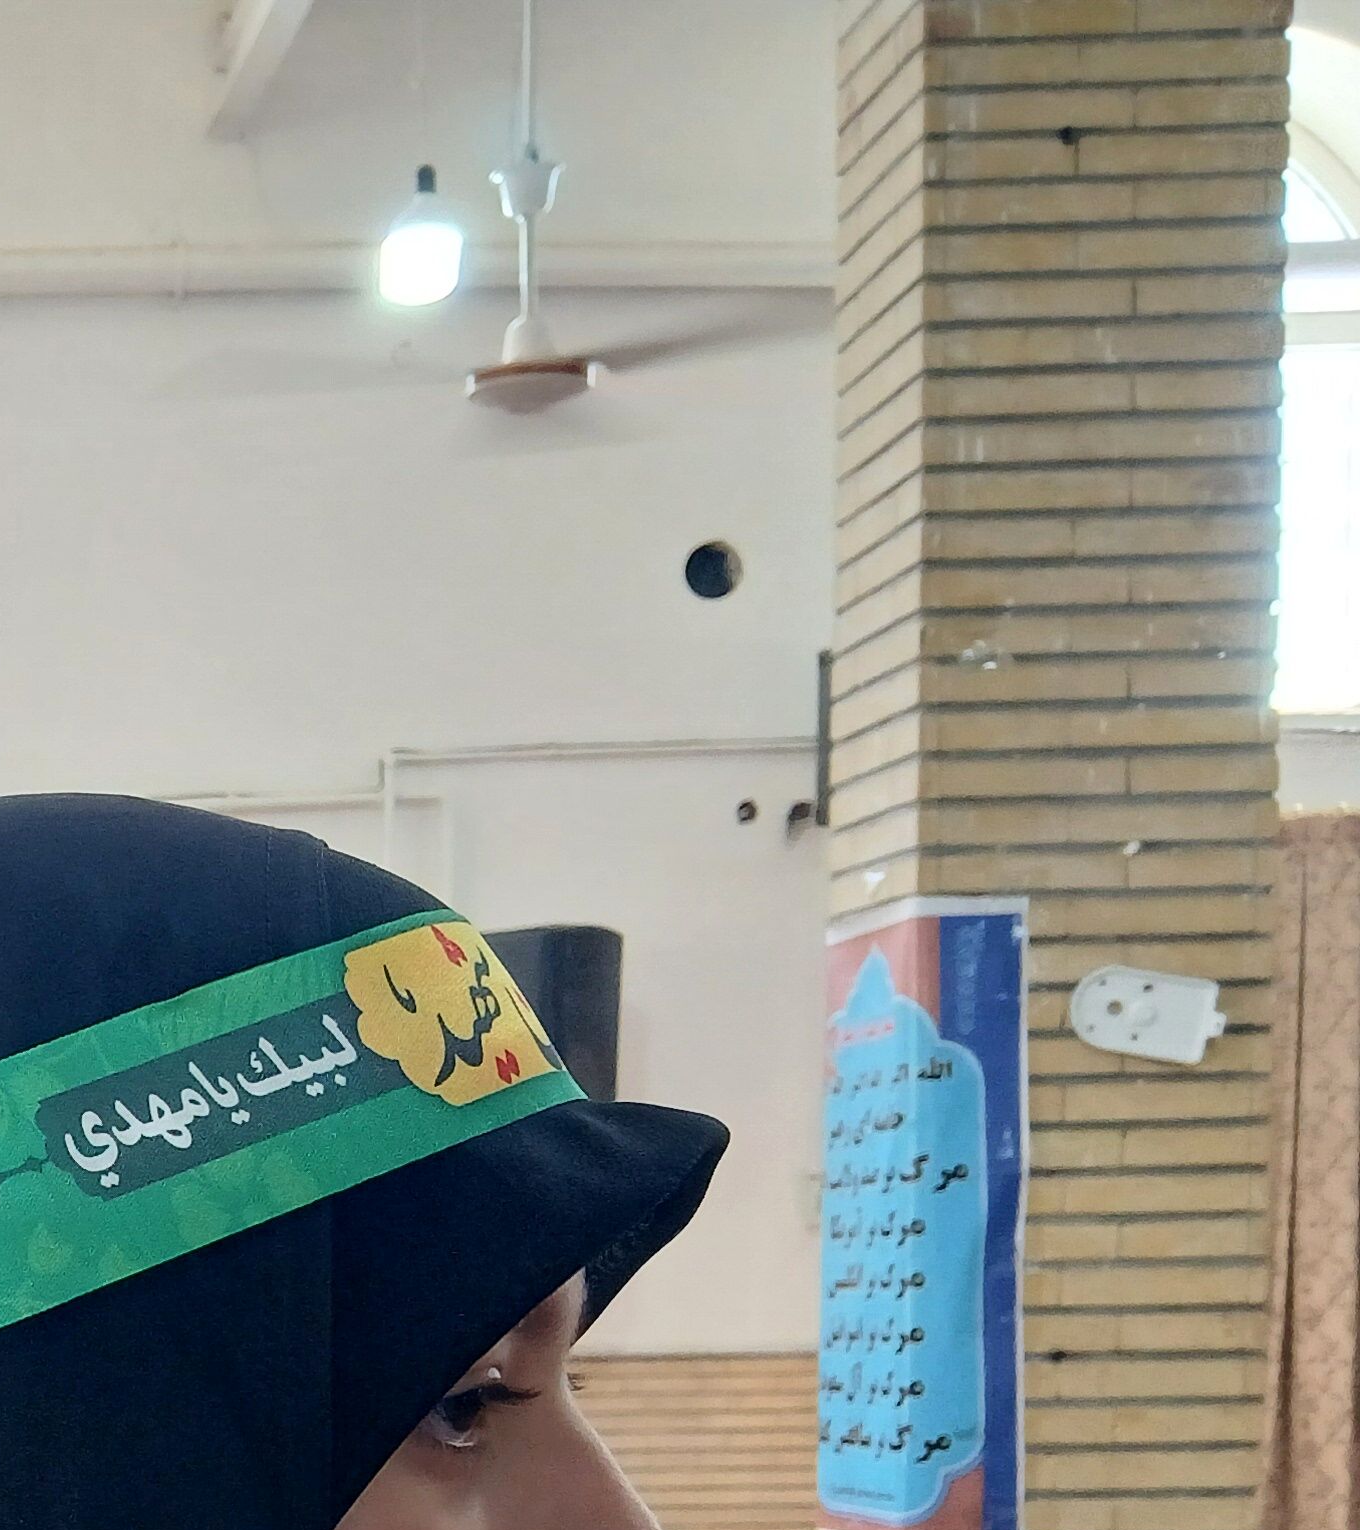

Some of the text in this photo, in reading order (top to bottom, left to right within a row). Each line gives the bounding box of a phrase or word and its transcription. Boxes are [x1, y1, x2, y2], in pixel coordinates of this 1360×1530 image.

[916, 1057, 953, 1082] الله
[899, 1153, 970, 1193] مرگ
[880, 1210, 926, 1248] مرگ
[880, 1263, 926, 1300] مرگ
[889, 1424, 952, 1464] مرگ
